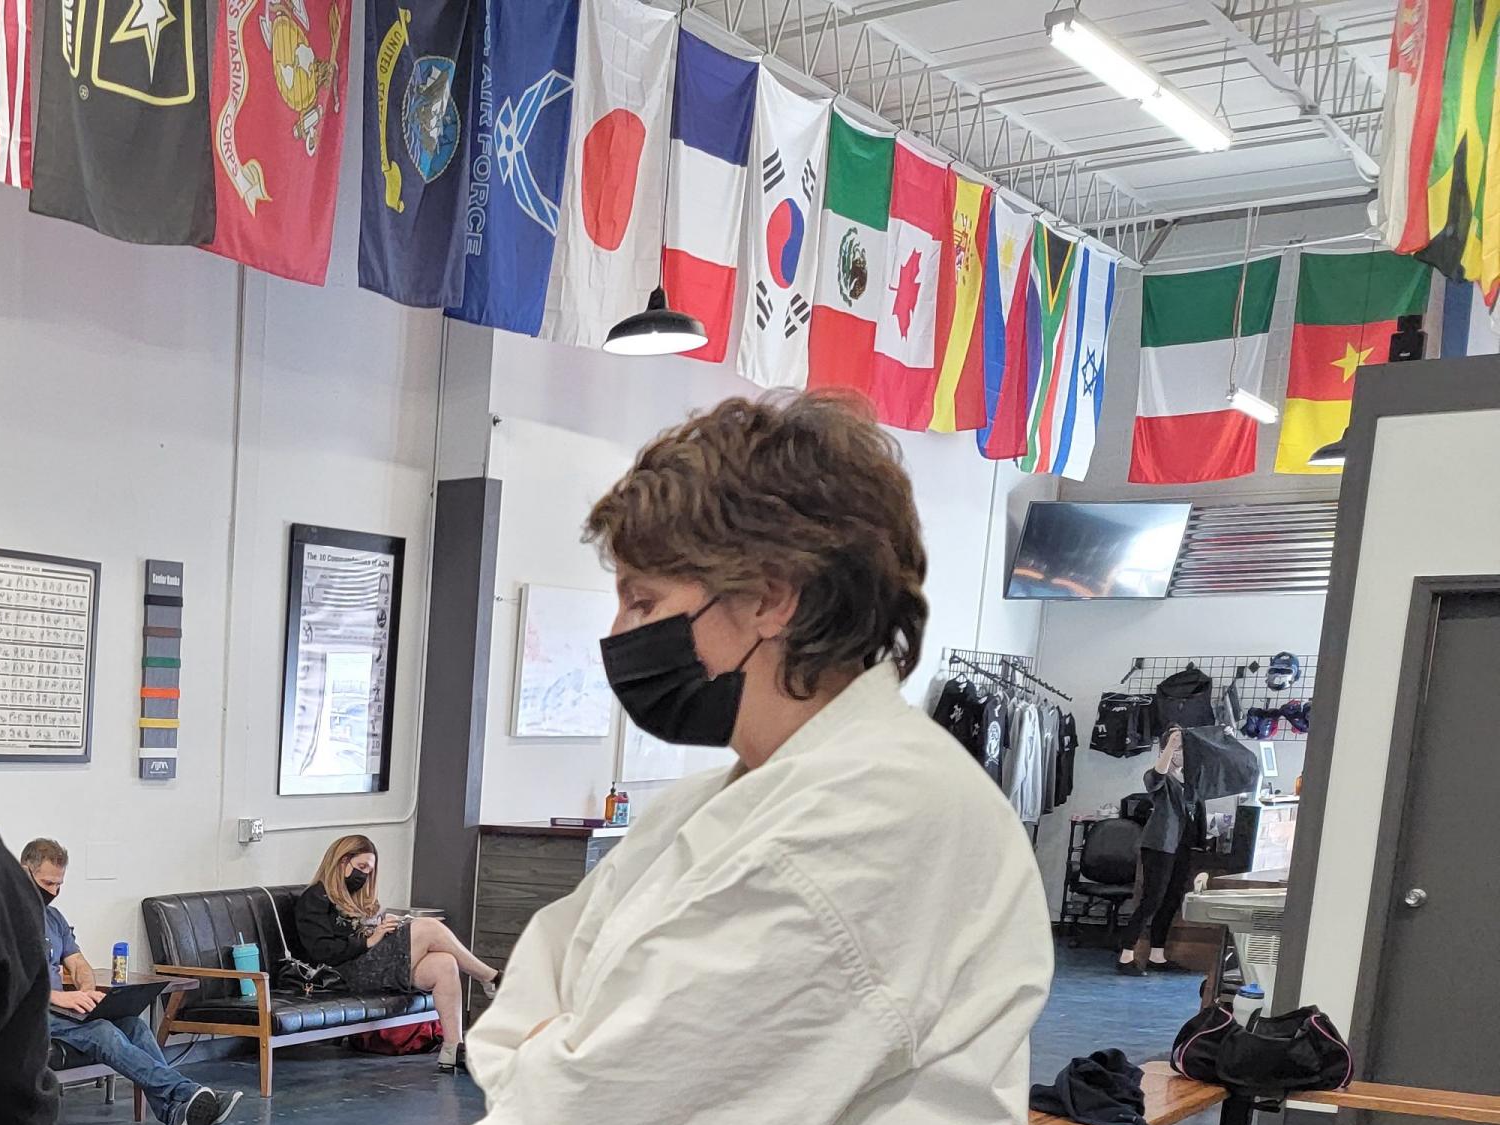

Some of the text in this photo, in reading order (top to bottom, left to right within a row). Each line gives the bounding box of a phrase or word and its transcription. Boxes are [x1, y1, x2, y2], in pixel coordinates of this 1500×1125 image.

[228, 29, 243, 108] MARINE
[379, 30, 402, 75] UNITED
[479, 63, 493, 128] AIR
[222, 114, 239, 177] CORPS
[465, 134, 493, 257] FORCE
